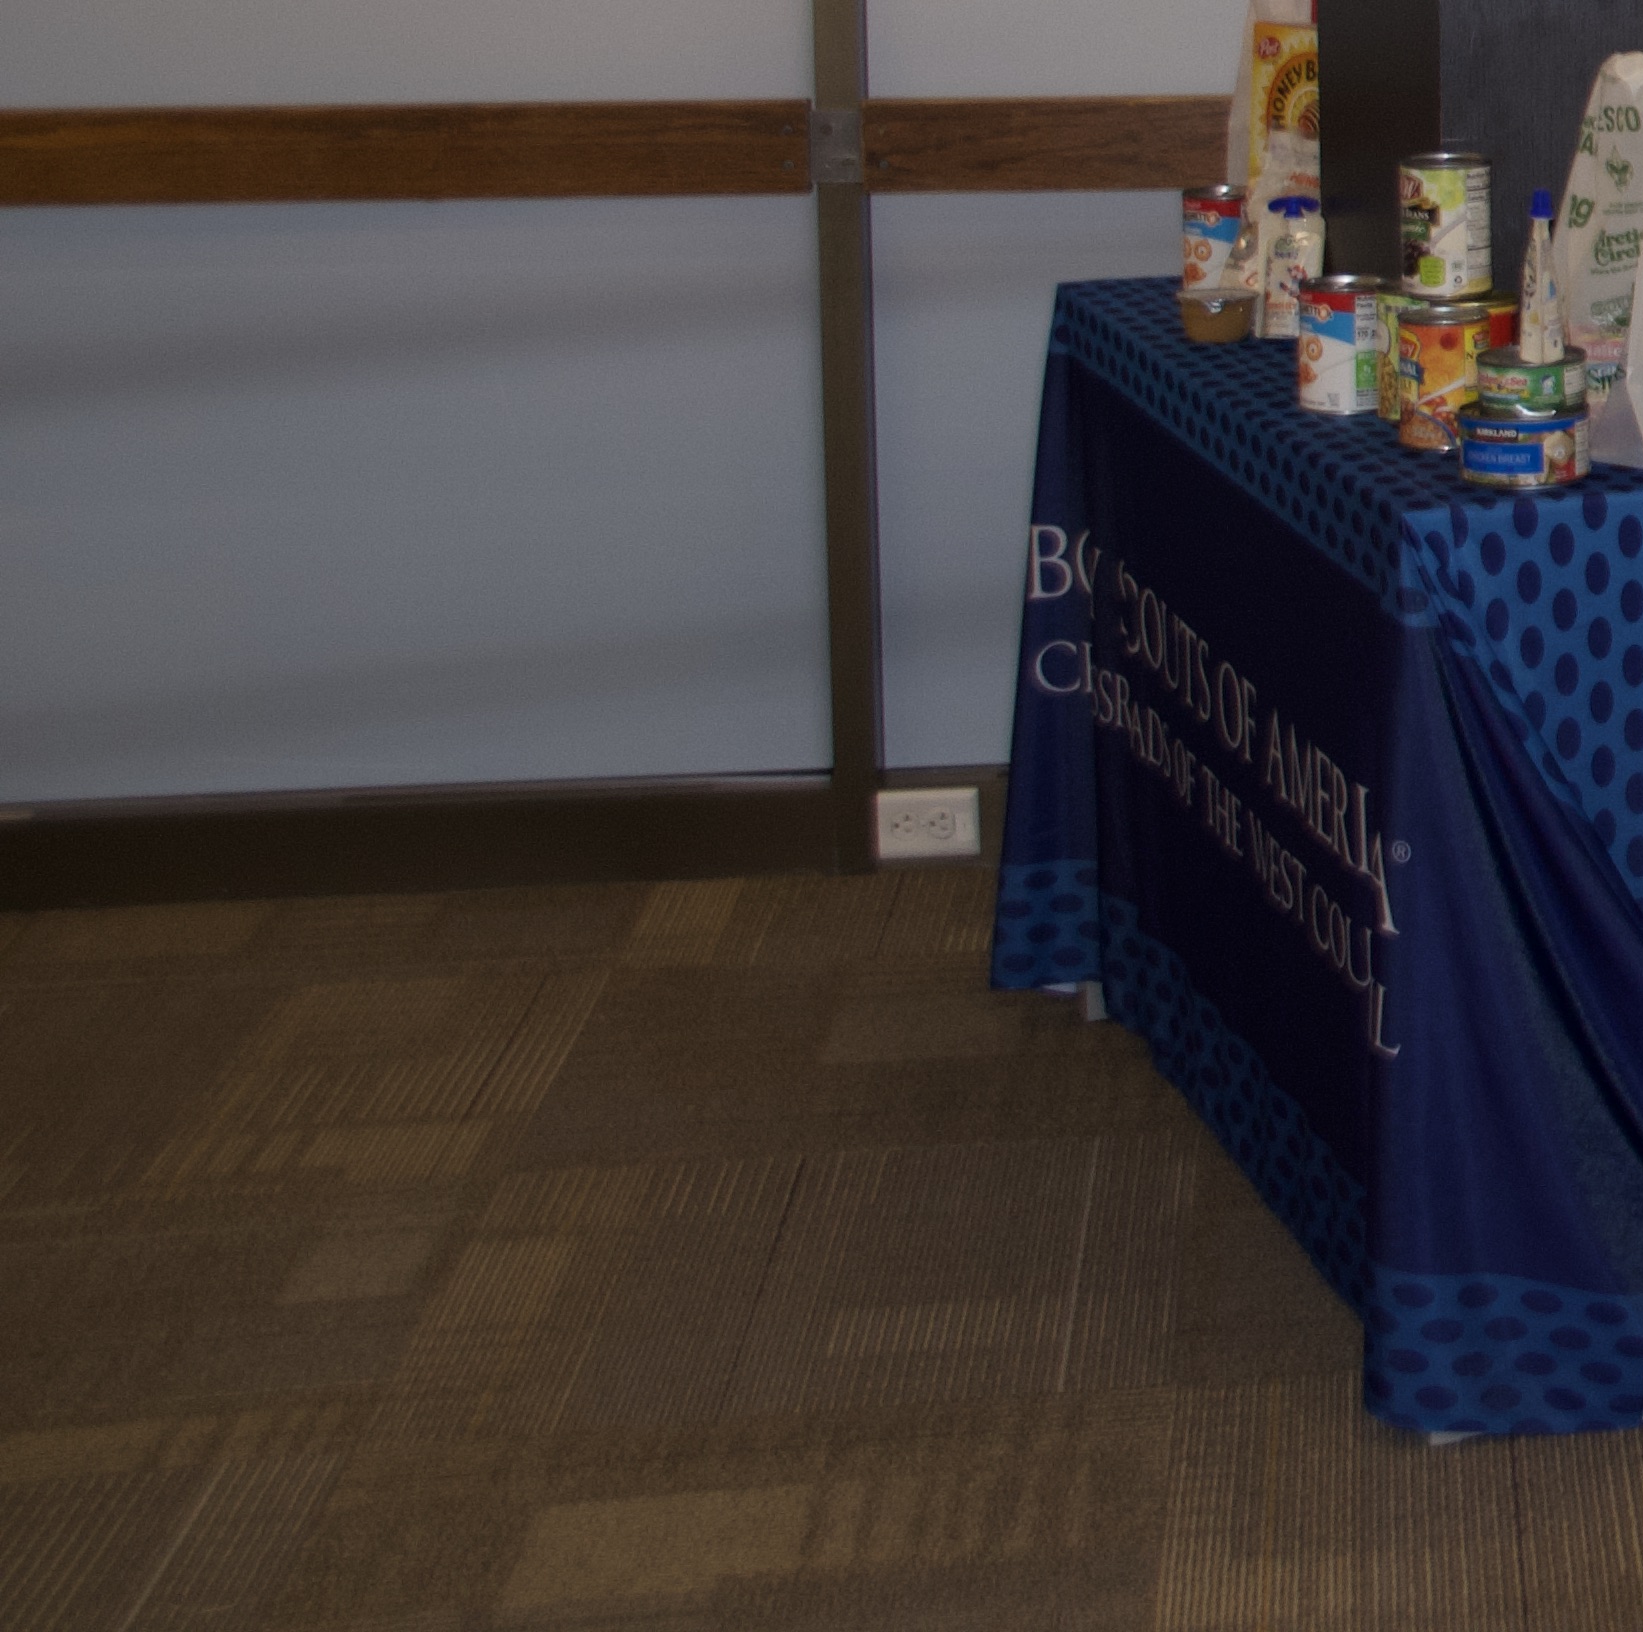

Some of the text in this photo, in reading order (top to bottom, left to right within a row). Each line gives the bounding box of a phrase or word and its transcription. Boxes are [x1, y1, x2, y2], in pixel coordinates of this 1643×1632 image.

[1271, 62, 1303, 129] HONEY
[1594, 244, 1641, 267] Circl
[1476, 427, 1517, 438] KIRKLAND
[1172, 737, 1197, 806] OF
[1201, 764, 1244, 858] THE
[1248, 809, 1307, 925] WEST
[1218, 660, 1257, 763] OF
[1266, 706, 1401, 936] AMERIA
